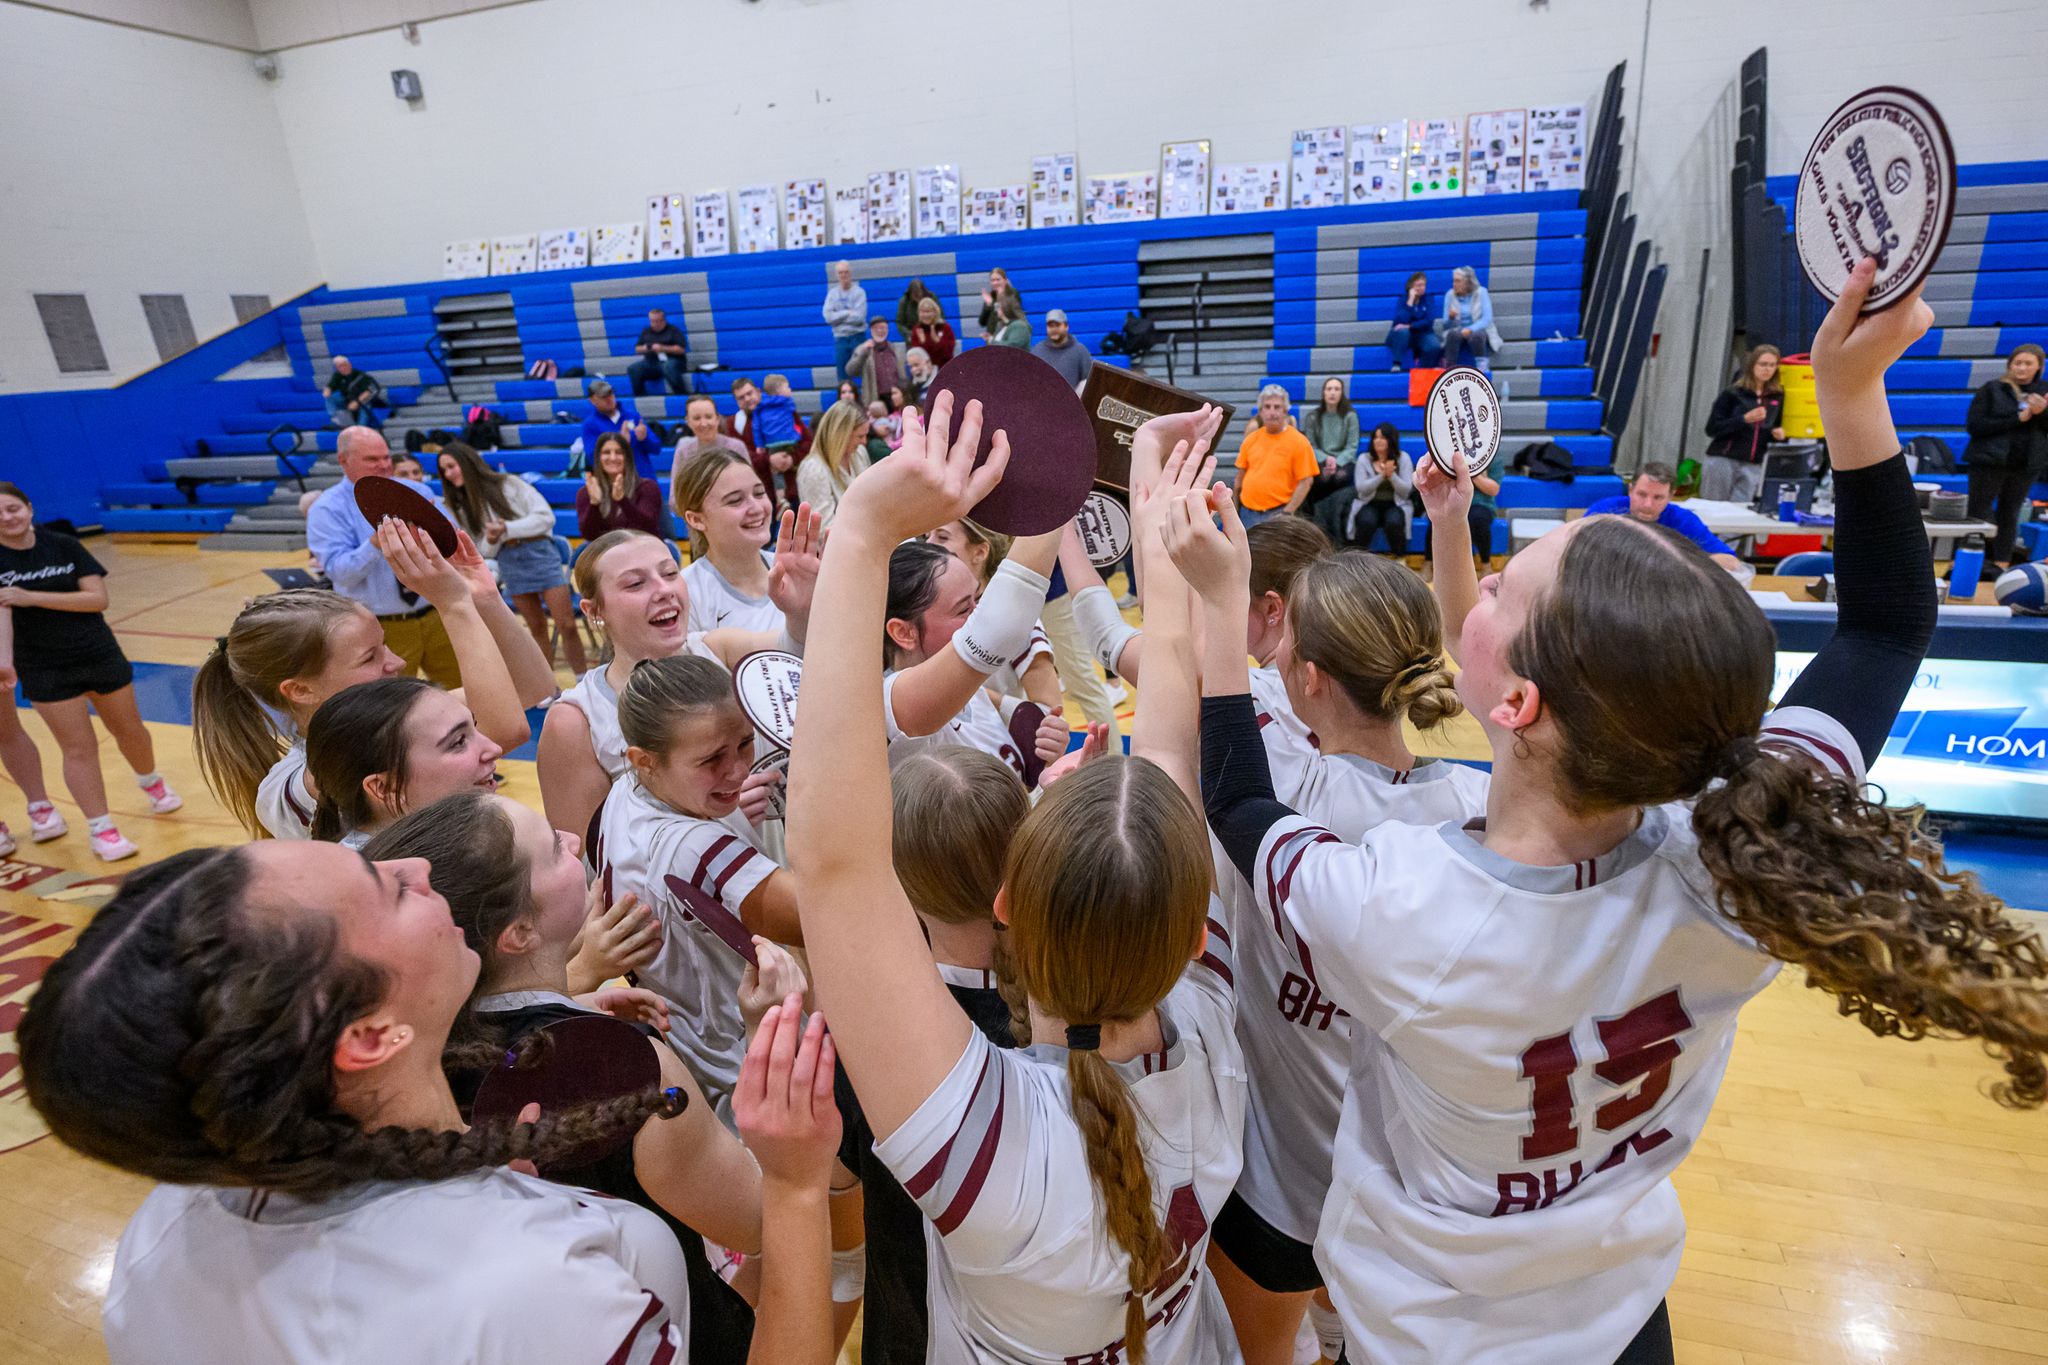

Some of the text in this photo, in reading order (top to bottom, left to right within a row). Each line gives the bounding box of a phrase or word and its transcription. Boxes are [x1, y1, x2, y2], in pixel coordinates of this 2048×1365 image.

[1846, 135, 1892, 238] SECTION
[1812, 161, 1829, 205] GIRLS
[1825, 206, 1857, 274] VOLLEYB
[1440, 389, 1460, 452] GIRLS VOLLEY
[1459, 387, 1480, 441] SECTION
[1077, 516, 1099, 555] SECTION
[1097, 499, 1113, 537] VOLLEYBALL
[1109, 538, 1119, 556] GIRLS
[0, 562, 76, 588] Spartans
[1517, 984, 1696, 1163] 15
